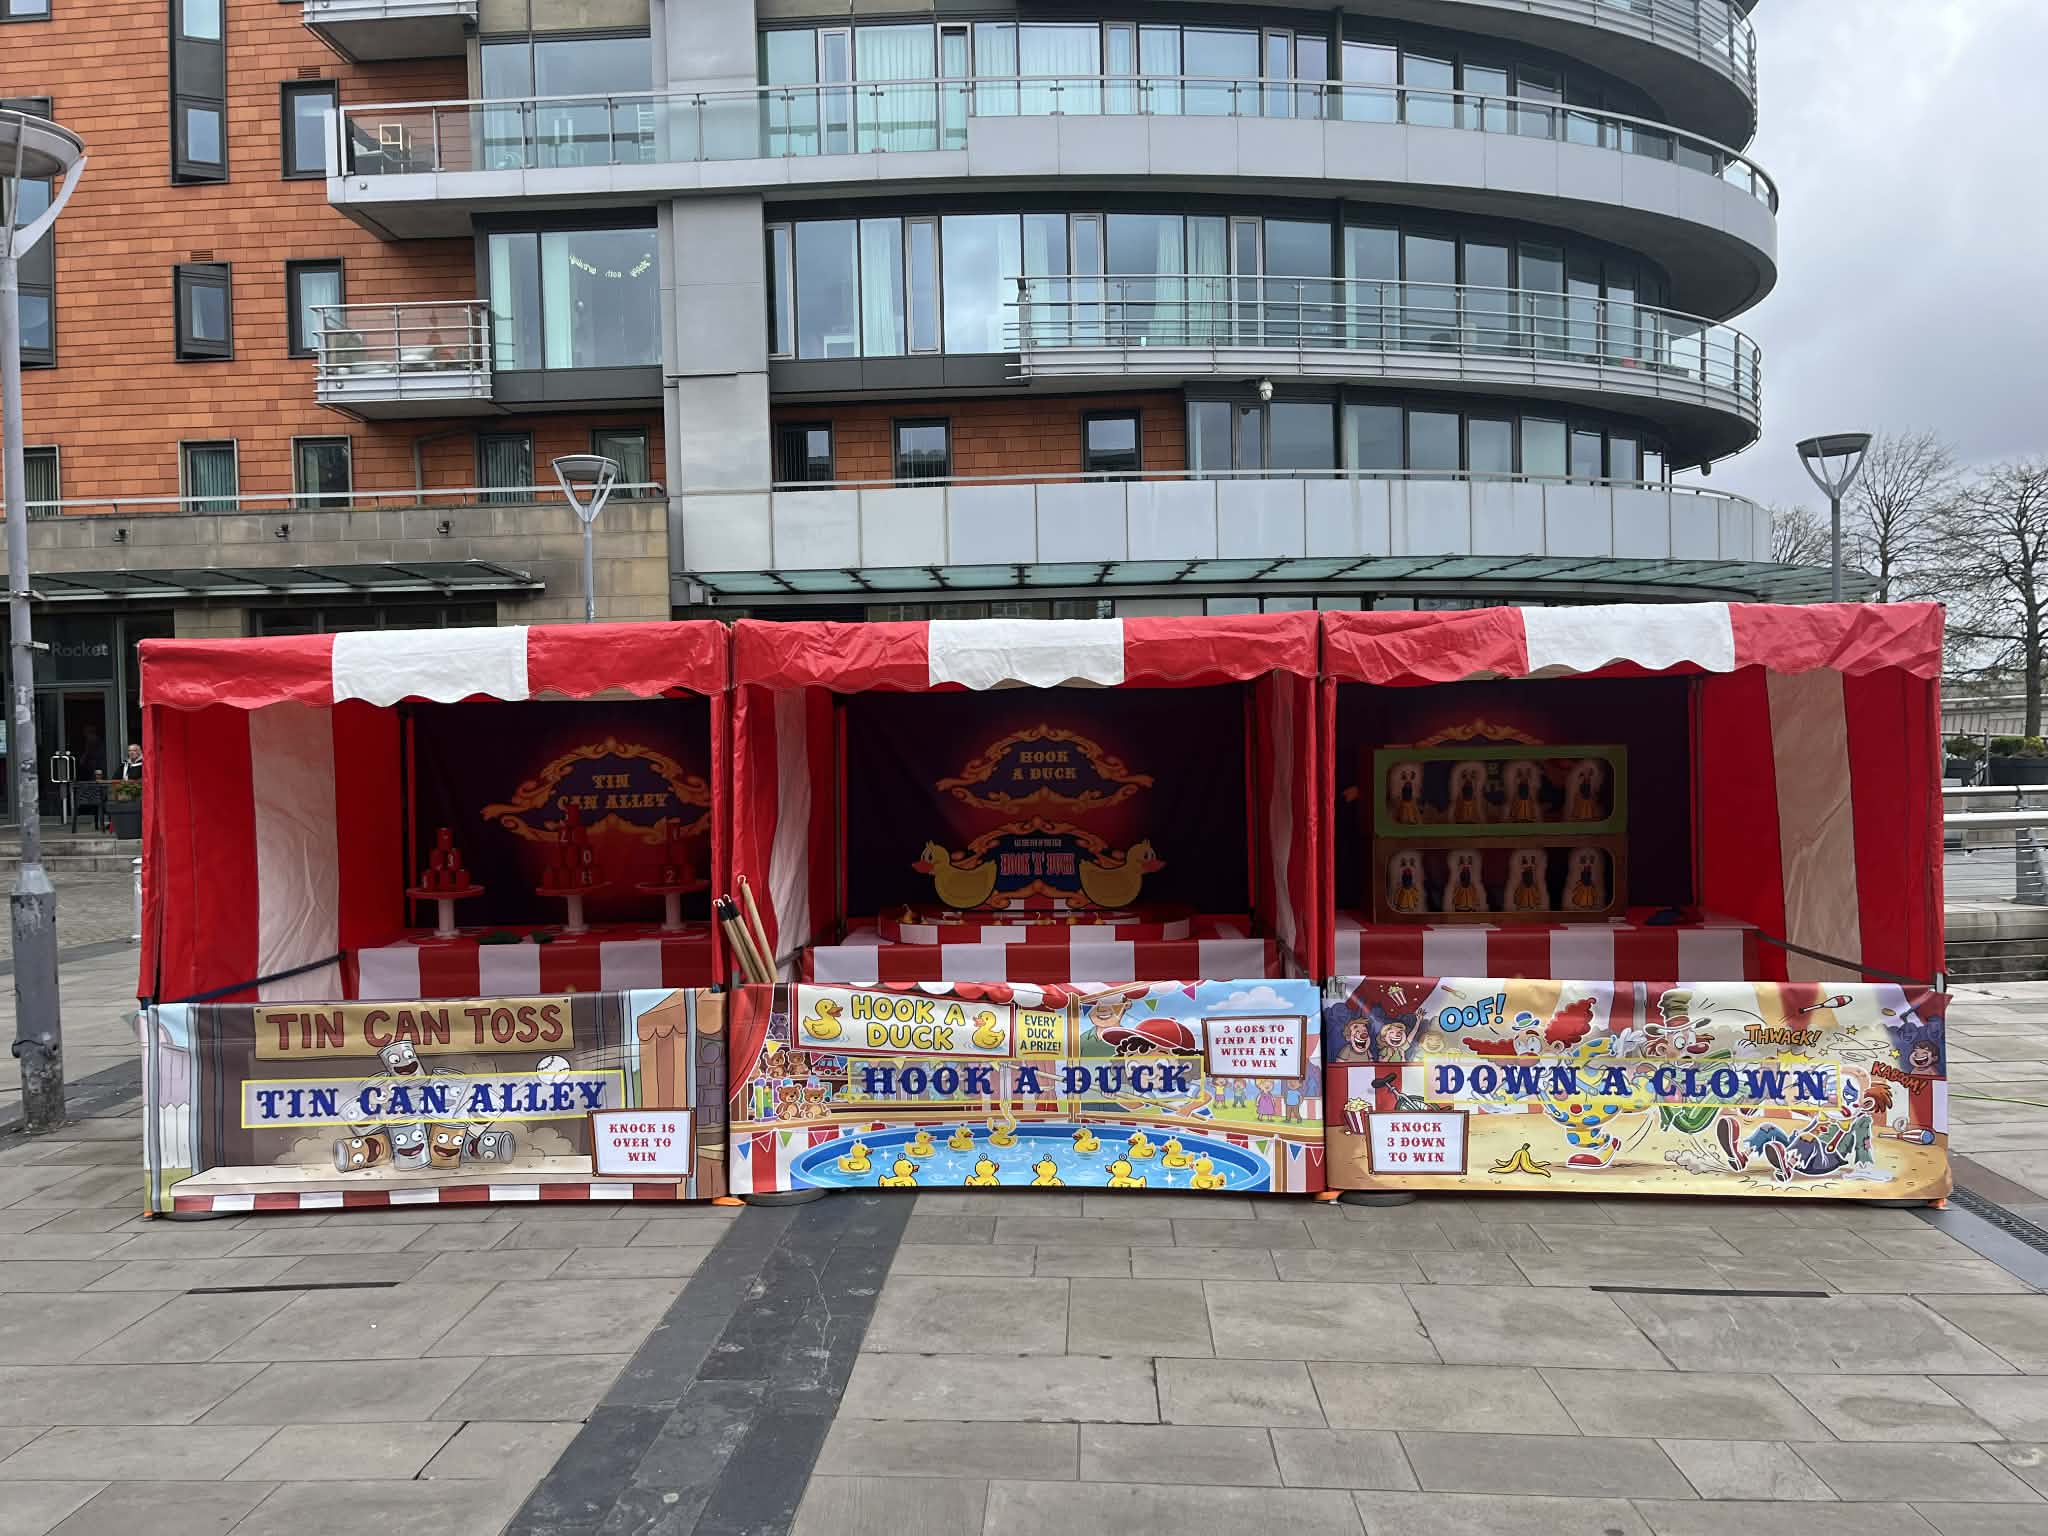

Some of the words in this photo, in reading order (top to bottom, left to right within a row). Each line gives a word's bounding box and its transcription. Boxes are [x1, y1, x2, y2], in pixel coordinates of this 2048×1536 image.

[1019, 751, 1070, 763] HOOK
[1012, 767, 1024, 780] A
[1030, 767, 1078, 780] DUCK
[592, 774, 631, 789] TIN
[606, 793, 669, 809] ALLEY
[851, 995, 934, 1024] HOOK
[944, 1003, 966, 1026] A
[1439, 993, 1507, 1032] OOF!
[266, 1011, 345, 1050] TIN
[363, 1008, 452, 1049] CAN
[464, 1004, 564, 1044] TOSS
[1024, 1014, 1056, 1028] EVERY
[1027, 1028, 1054, 1039] DUCK
[1224, 1025, 1231, 1034] 3
[1235, 1025, 1265, 1033] GOES
[1269, 1024, 1285, 1033] TO
[866, 1021, 954, 1050] DUCK
[1215, 1036, 1244, 1045] FIND
[1248, 1036, 1256, 1044] A
[1261, 1036, 1294, 1045] DUCK
[1744, 1024, 1823, 1048] THWACK!
[1020, 1041, 1028, 1050] A
[1030, 1041, 1061, 1051] PRIZE!
[1221, 1047, 1254, 1056] WITH
[1259, 1047, 1276, 1056] AN
[1280, 1048, 1289, 1056] X
[1232, 1059, 1247, 1067] TO
[1251, 1059, 1277, 1068] WIN
[862, 1066, 996, 1095] HOOK
[1012, 1065, 1044, 1094] A
[1062, 1064, 1191, 1094] DUCK
[1435, 1064, 1581, 1095] DOWN
[1600, 1066, 1633, 1096] A
[1649, 1066, 1829, 1101] CLOWN
[1871, 1061, 1928, 1095] KABOOM!
[257, 1087, 340, 1119] TIN
[357, 1084, 450, 1116] CAN
[468, 1080, 606, 1114] ALLEY
[609, 1123, 656, 1133] KNOCK
[1391, 1122, 1442, 1132] KNOCK
[613, 1138, 649, 1147] OVER
[654, 1138, 671, 1147] TO
[1387, 1137, 1395, 1147] 3
[1400, 1137, 1446, 1147] DOWN
[628, 1151, 657, 1161] WIN
[1388, 1152, 1407, 1162] TO
[1413, 1152, 1444, 1162] WIN
